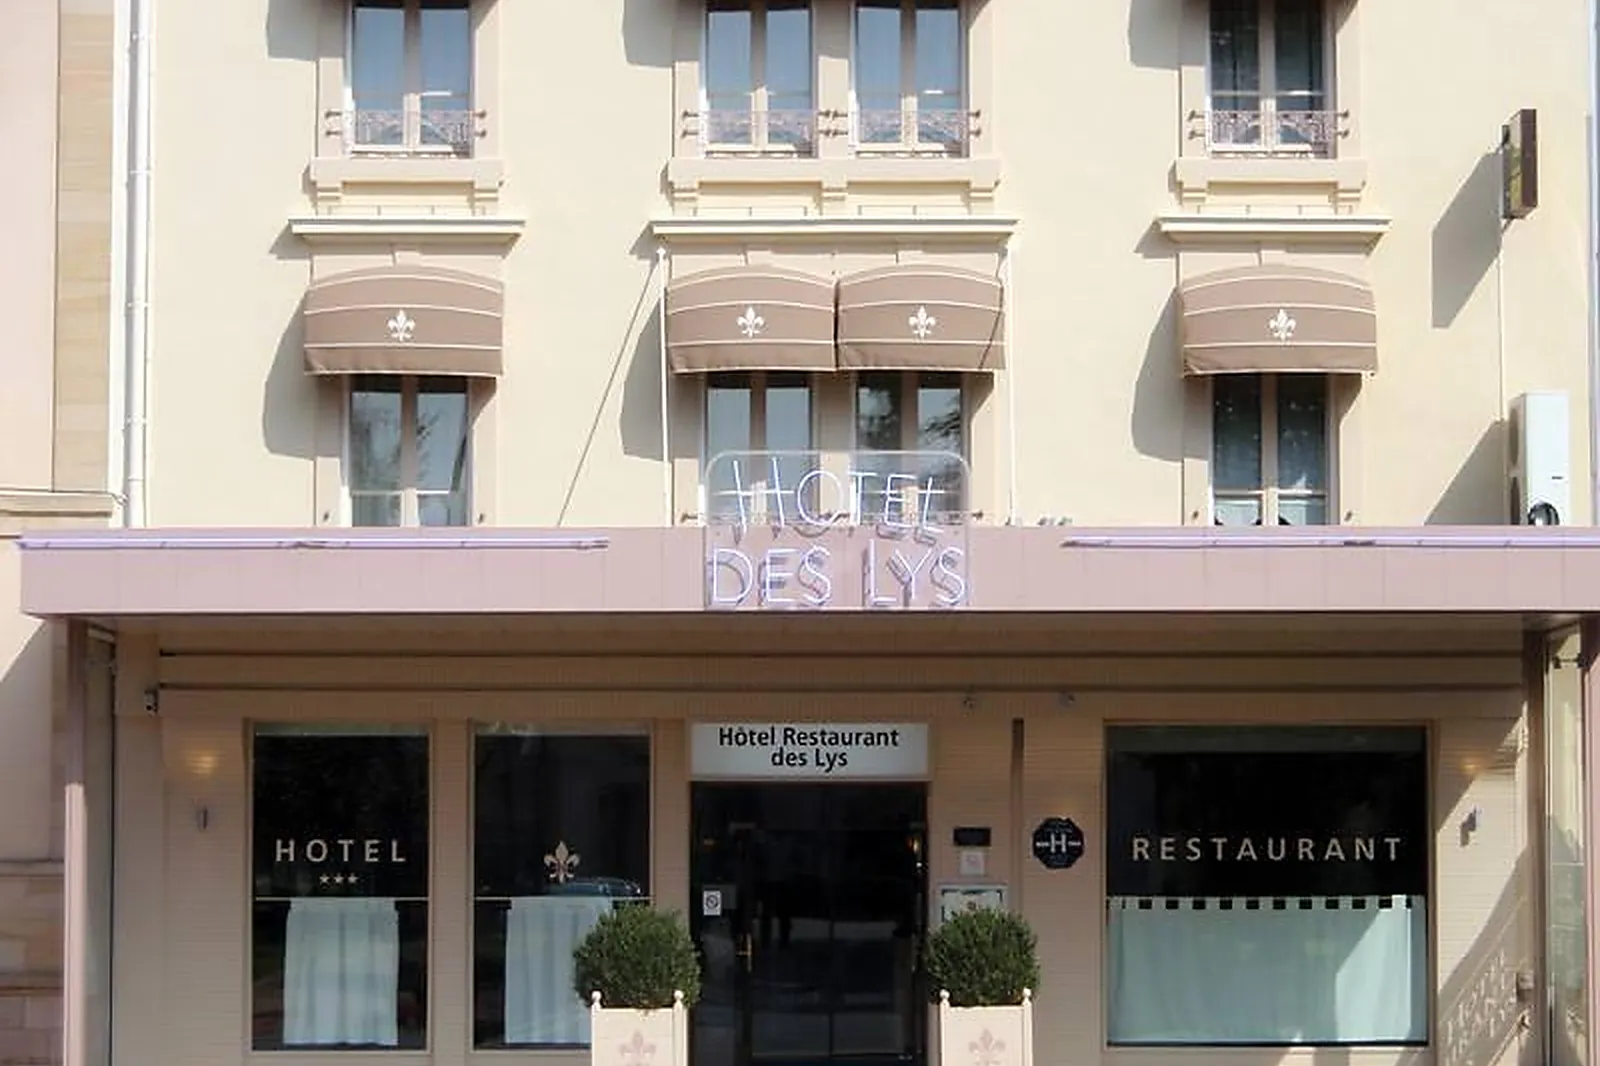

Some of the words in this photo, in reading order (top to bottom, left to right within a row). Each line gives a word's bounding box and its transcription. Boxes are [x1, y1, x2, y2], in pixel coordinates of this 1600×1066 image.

[731, 456, 945, 535] HOTEL
[711, 545, 833, 605] DES
[868, 539, 966, 605] LYS
[719, 726, 775, 747] Hôtel
[783, 727, 899, 747] Restaurant
[771, 748, 807, 767] des
[815, 748, 848, 773] Lys
[275, 839, 407, 862] HOTEL
[1050, 832, 1067, 854] H
[1131, 837, 1402, 862] RESTAURANT
